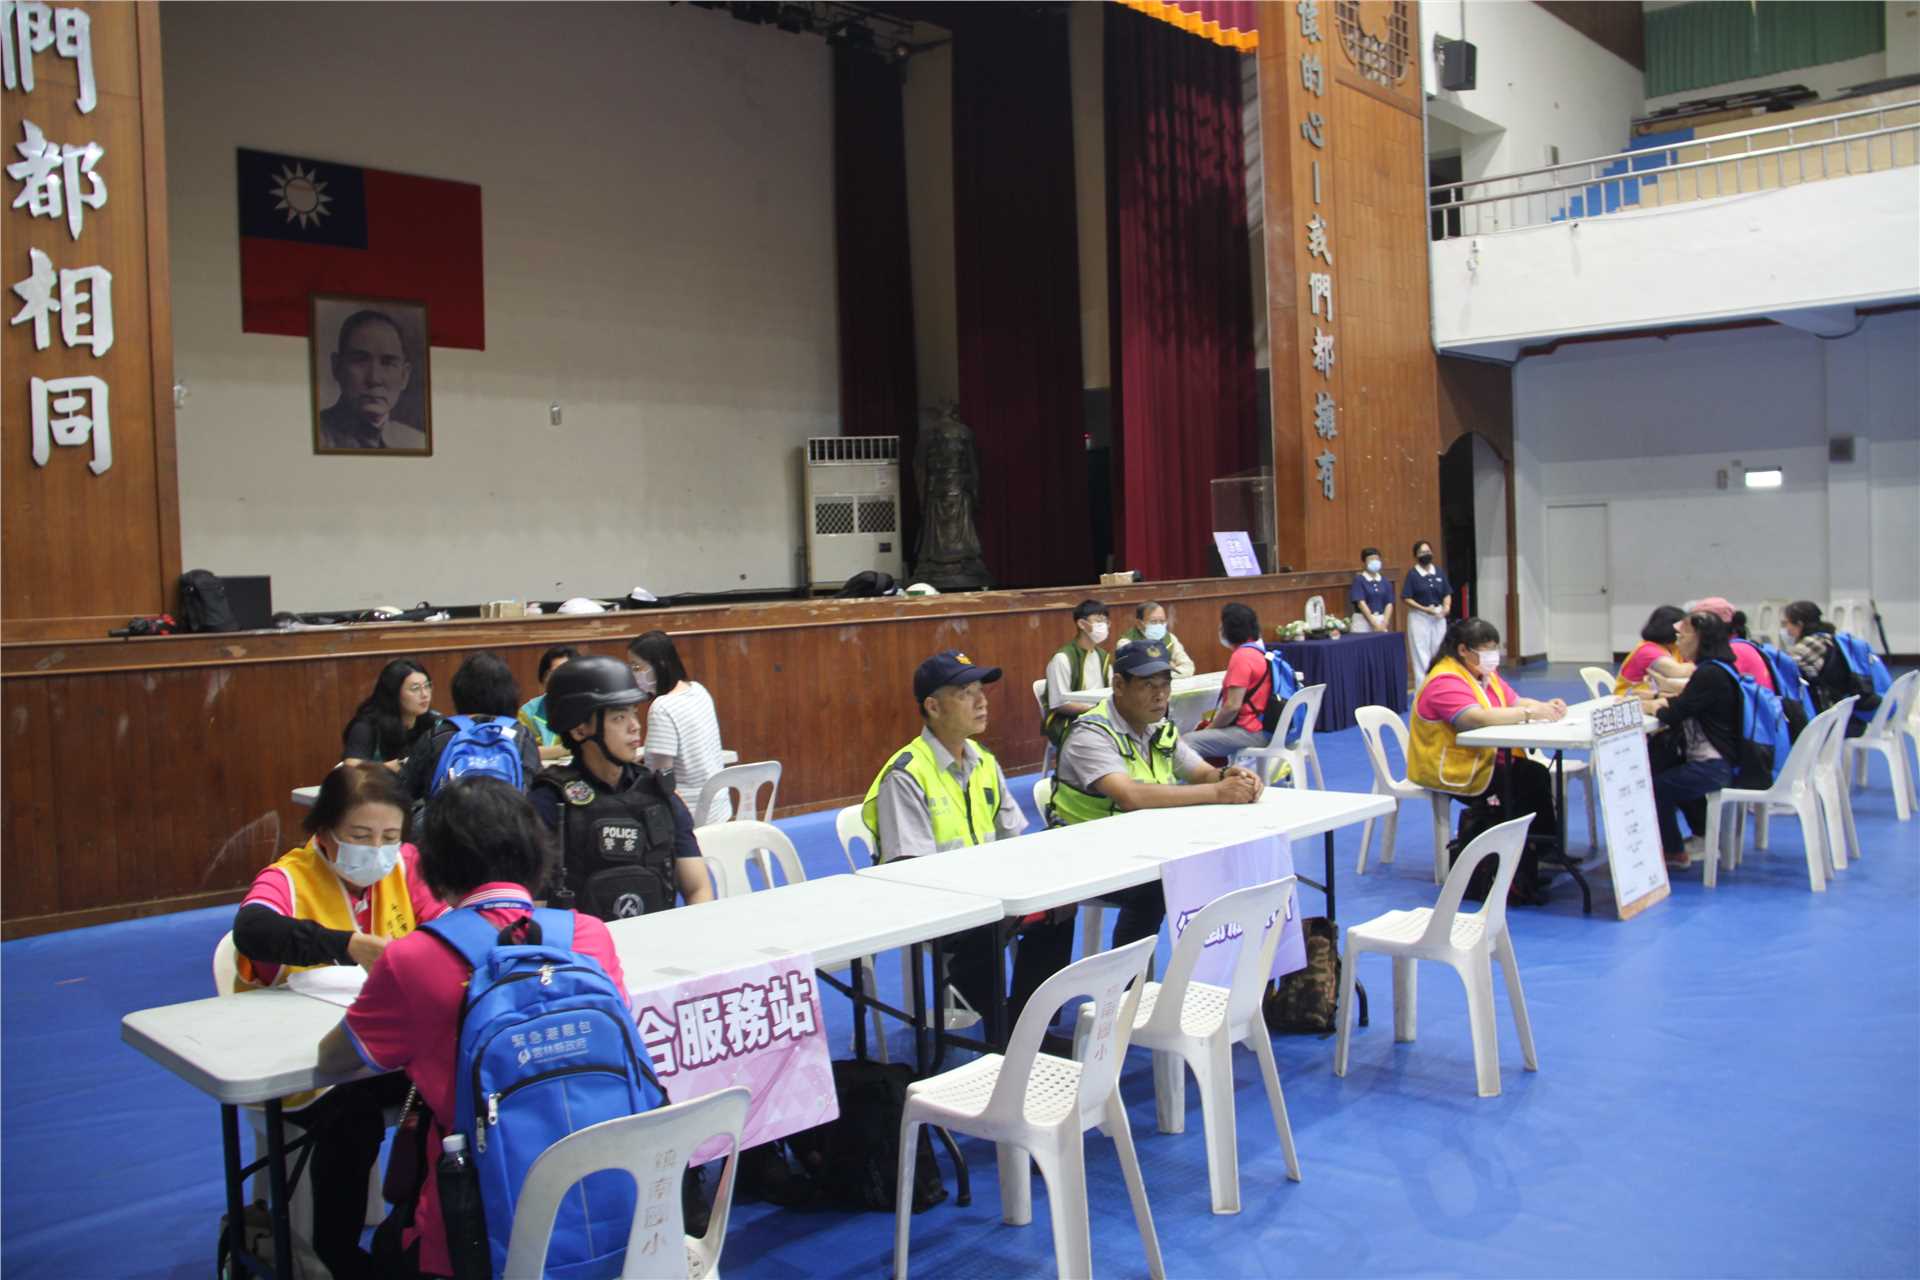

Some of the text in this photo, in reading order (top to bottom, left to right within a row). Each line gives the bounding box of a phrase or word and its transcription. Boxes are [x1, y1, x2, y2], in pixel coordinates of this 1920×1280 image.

[0, 0, 114, 476] 們都相同
[602, 826, 638, 839] POLICE
[636, 970, 817, 1077] 合服務站
